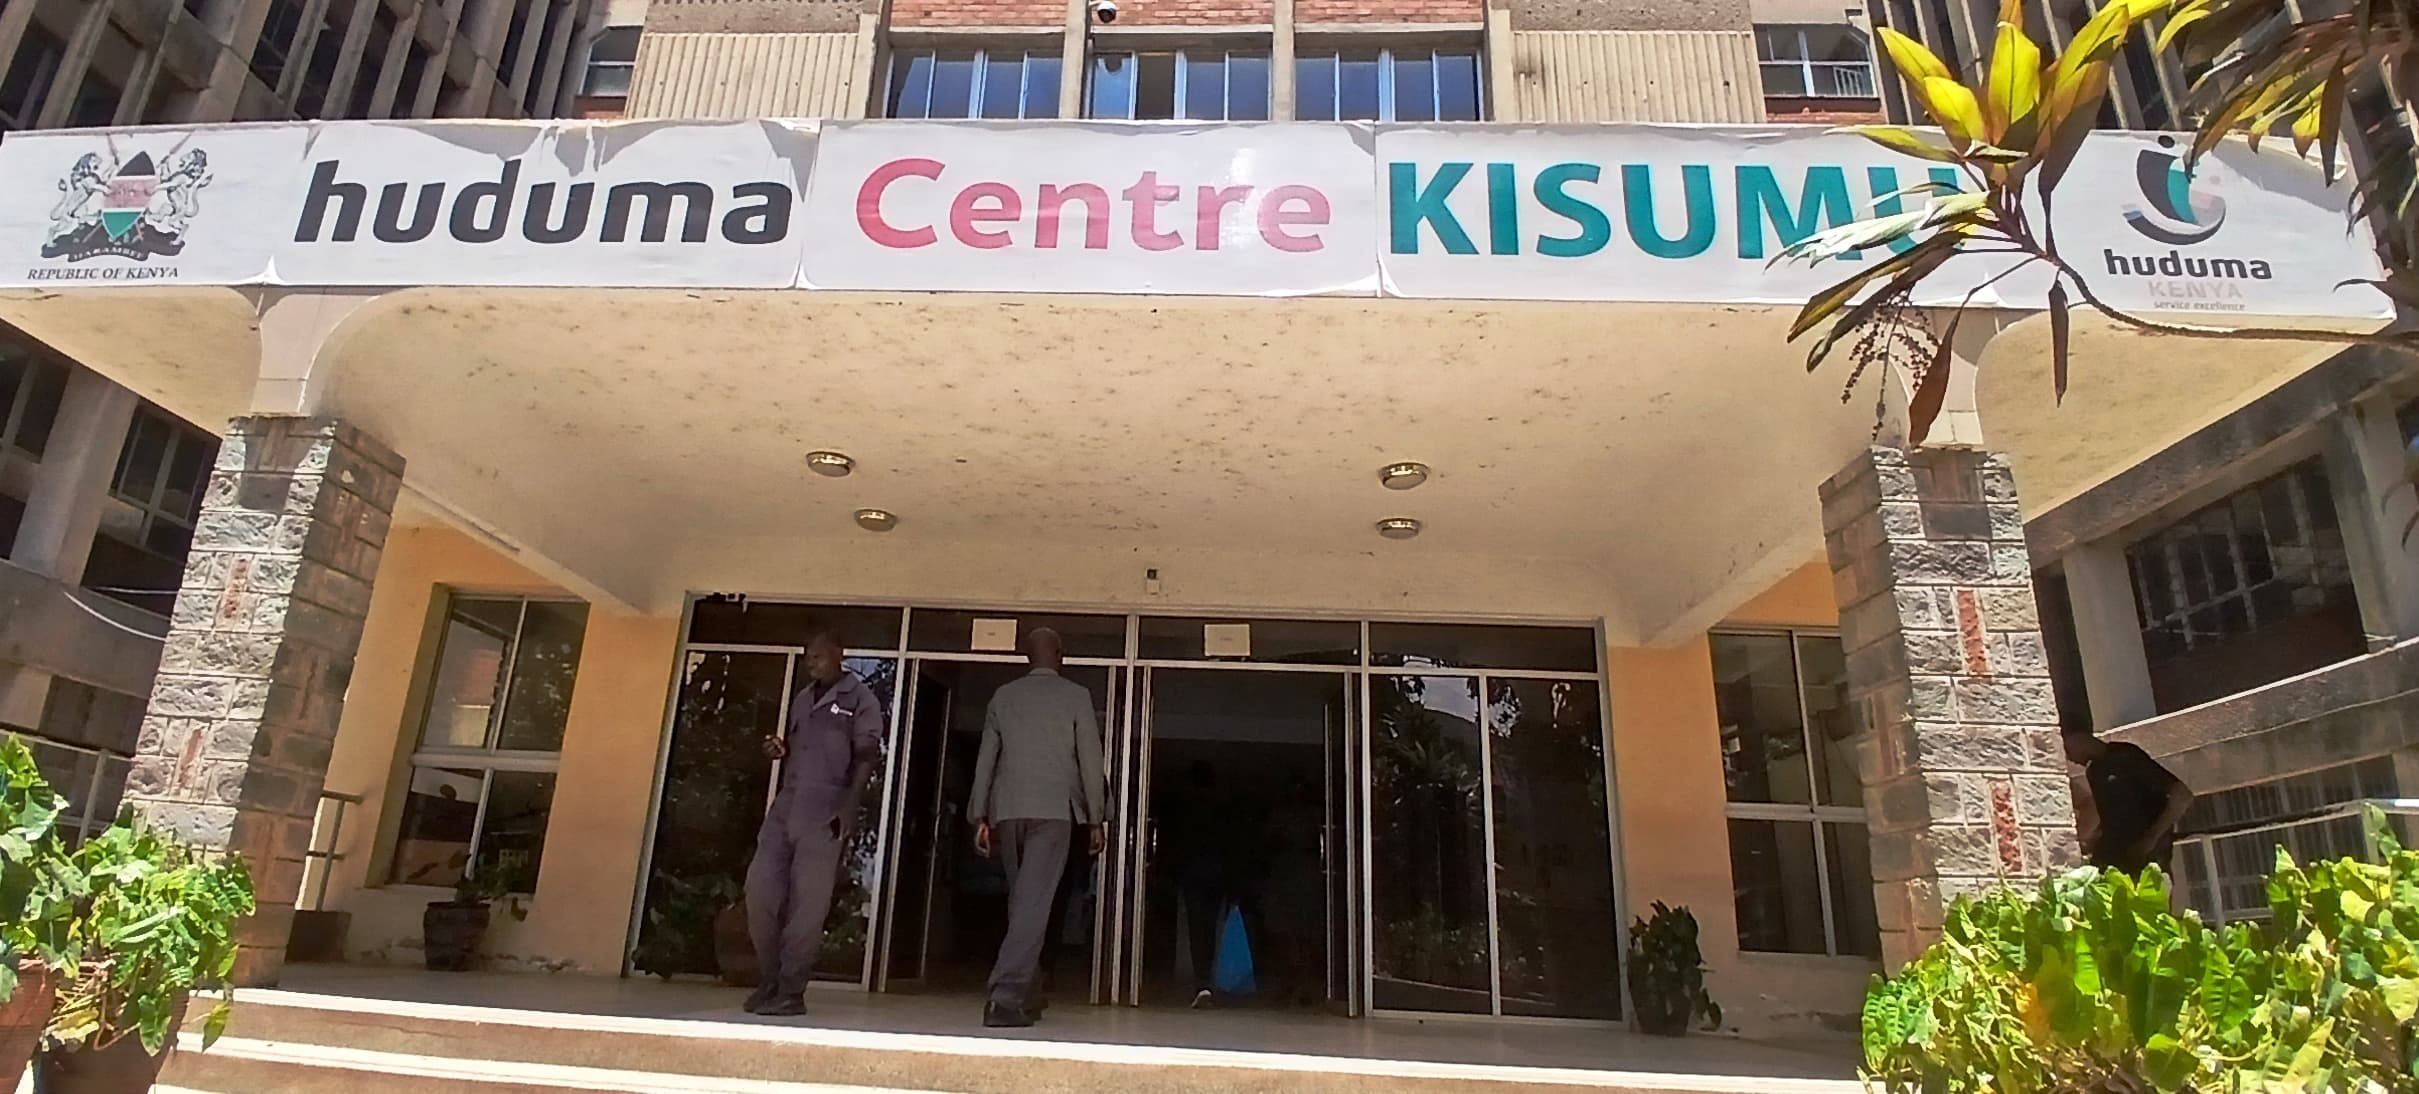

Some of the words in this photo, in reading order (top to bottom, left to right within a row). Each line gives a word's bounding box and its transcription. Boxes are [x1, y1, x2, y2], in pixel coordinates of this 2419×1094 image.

[293, 157, 792, 245] huduma
[855, 157, 1331, 253] Centre
[2103, 249, 2272, 280] huduma
[27, 268, 98, 280] REPUBLIC
[102, 268, 121, 280] OF
[126, 267, 179, 279] KENYA
[2149, 281, 2242, 298] KENYA
[2154, 301, 2190, 309] service
[2194, 302, 2245, 311] excellence
